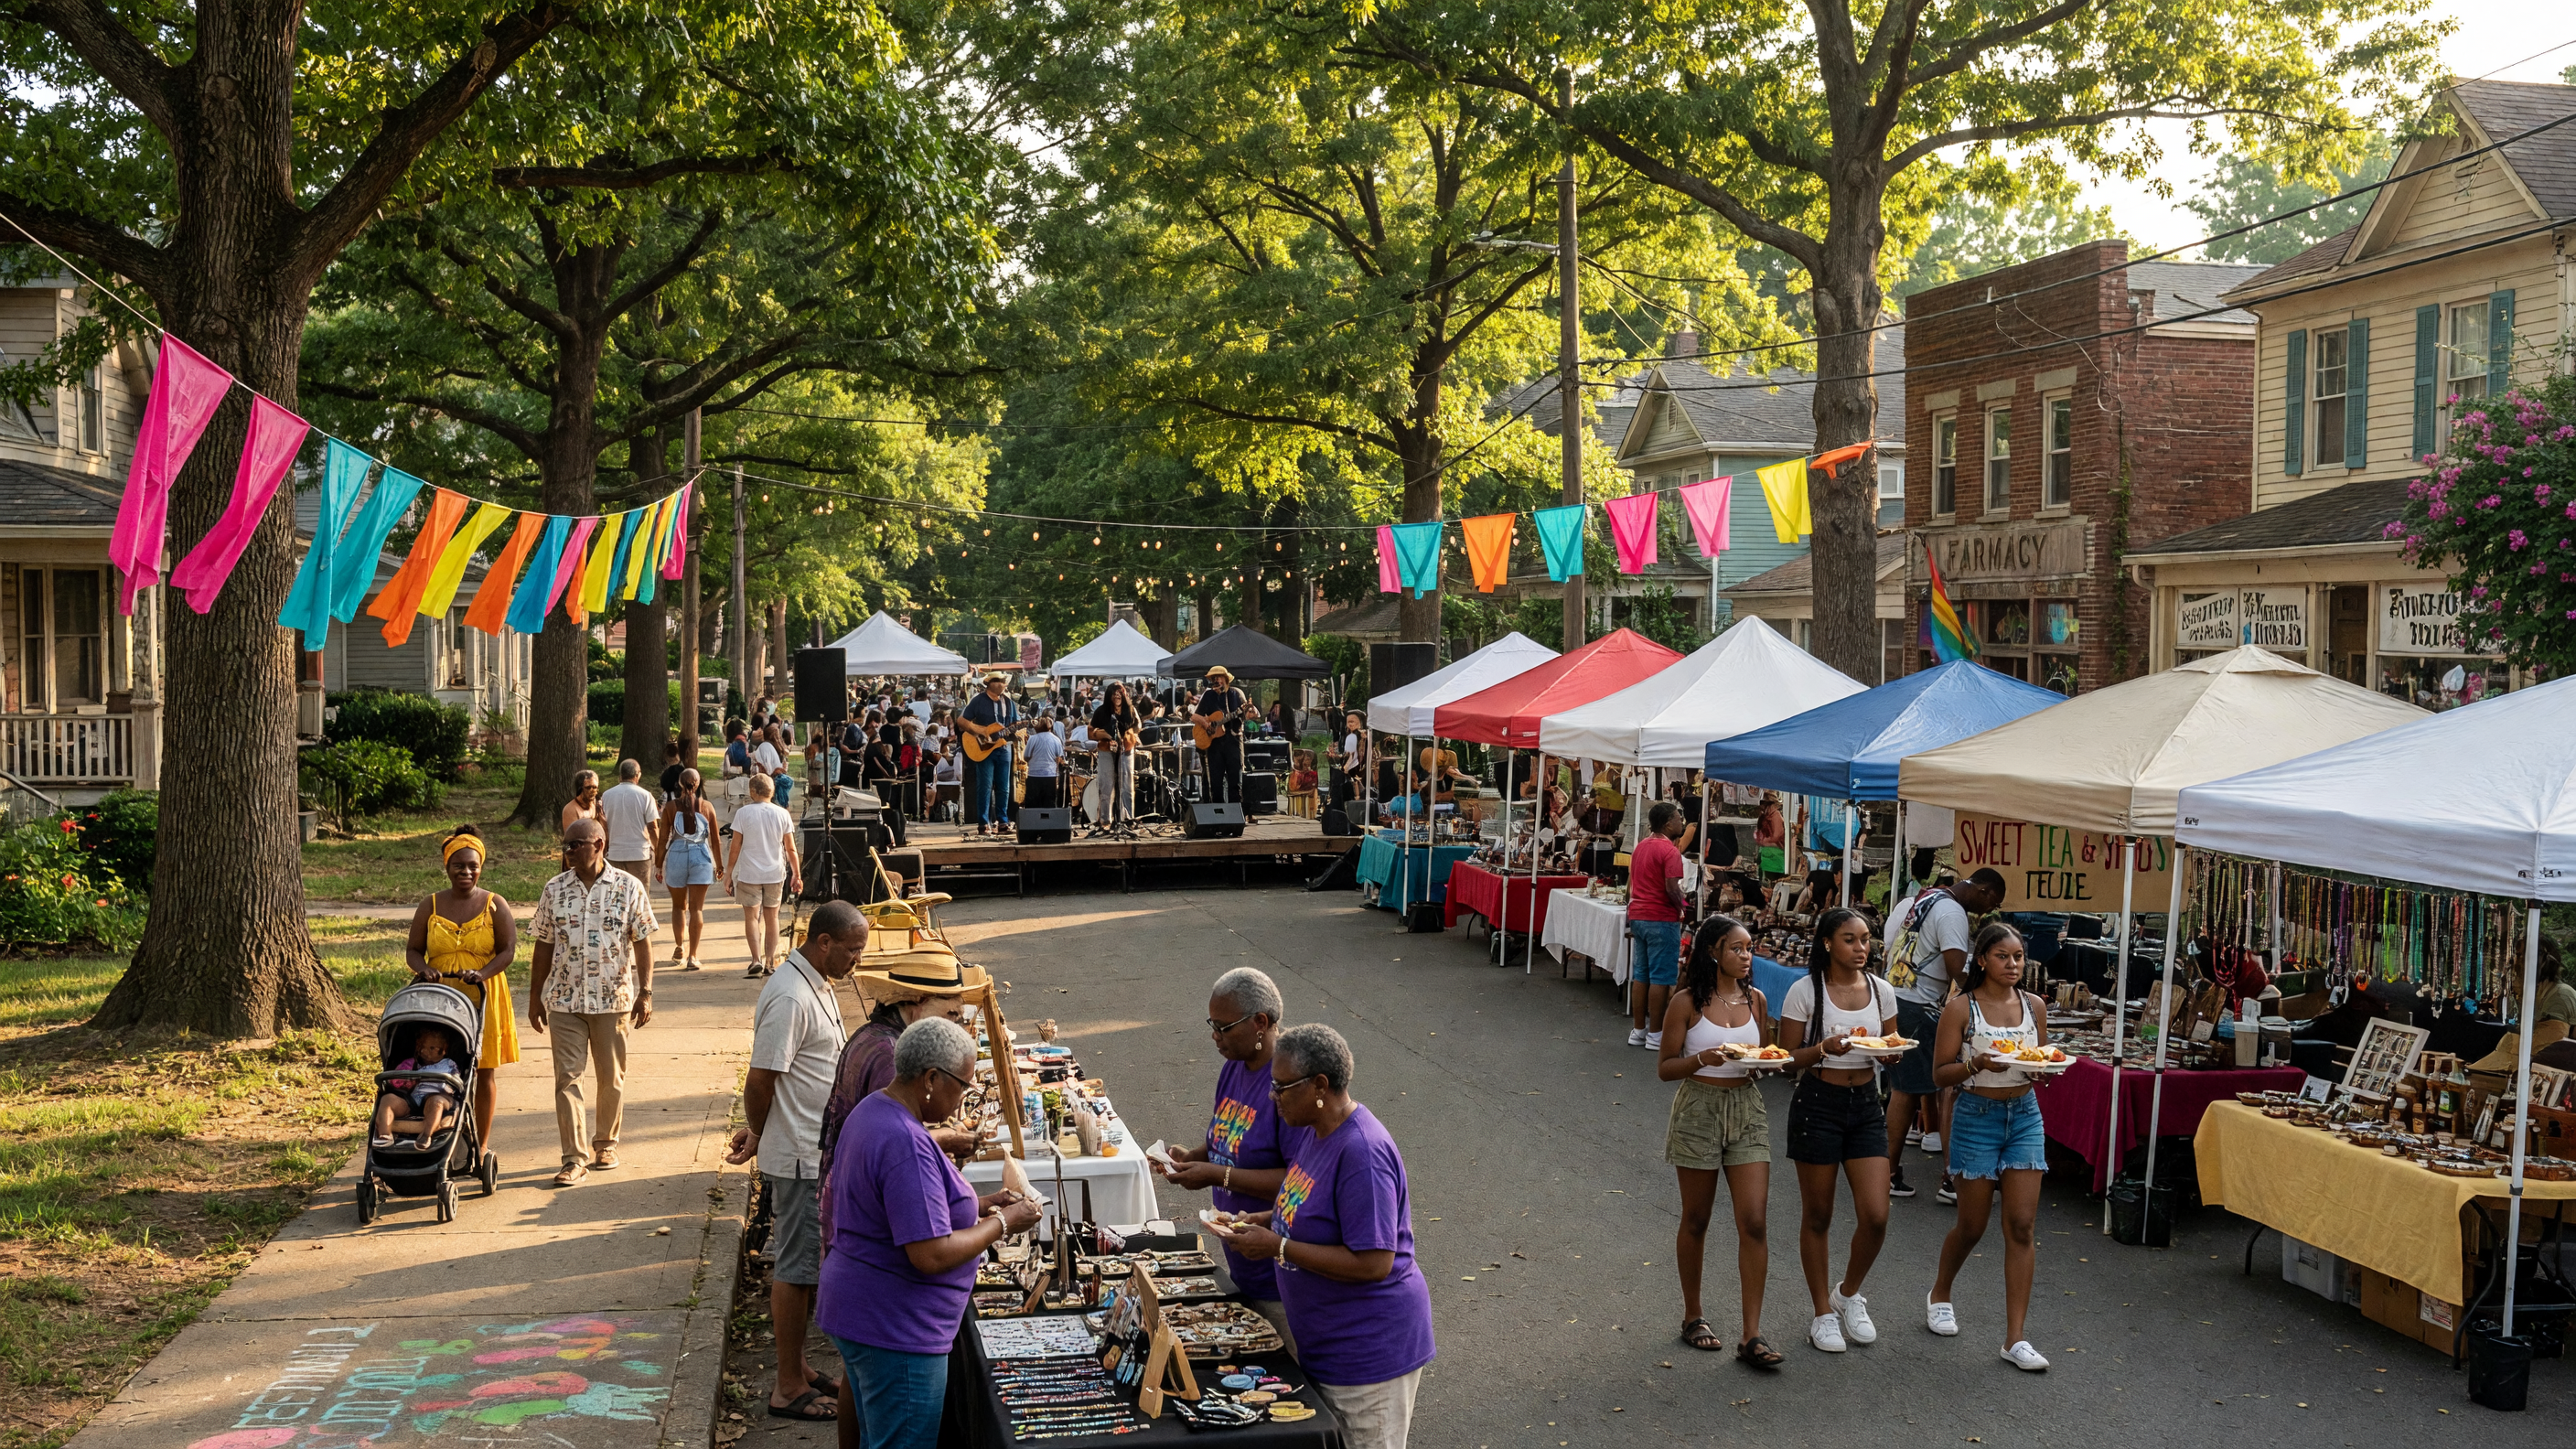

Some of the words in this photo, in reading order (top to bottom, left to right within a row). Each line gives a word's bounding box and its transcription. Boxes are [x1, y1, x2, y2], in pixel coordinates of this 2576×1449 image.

[1960, 820, 2027, 866] SWEET
[2034, 824, 2074, 869] TEA
[2081, 833, 2097, 863] &
